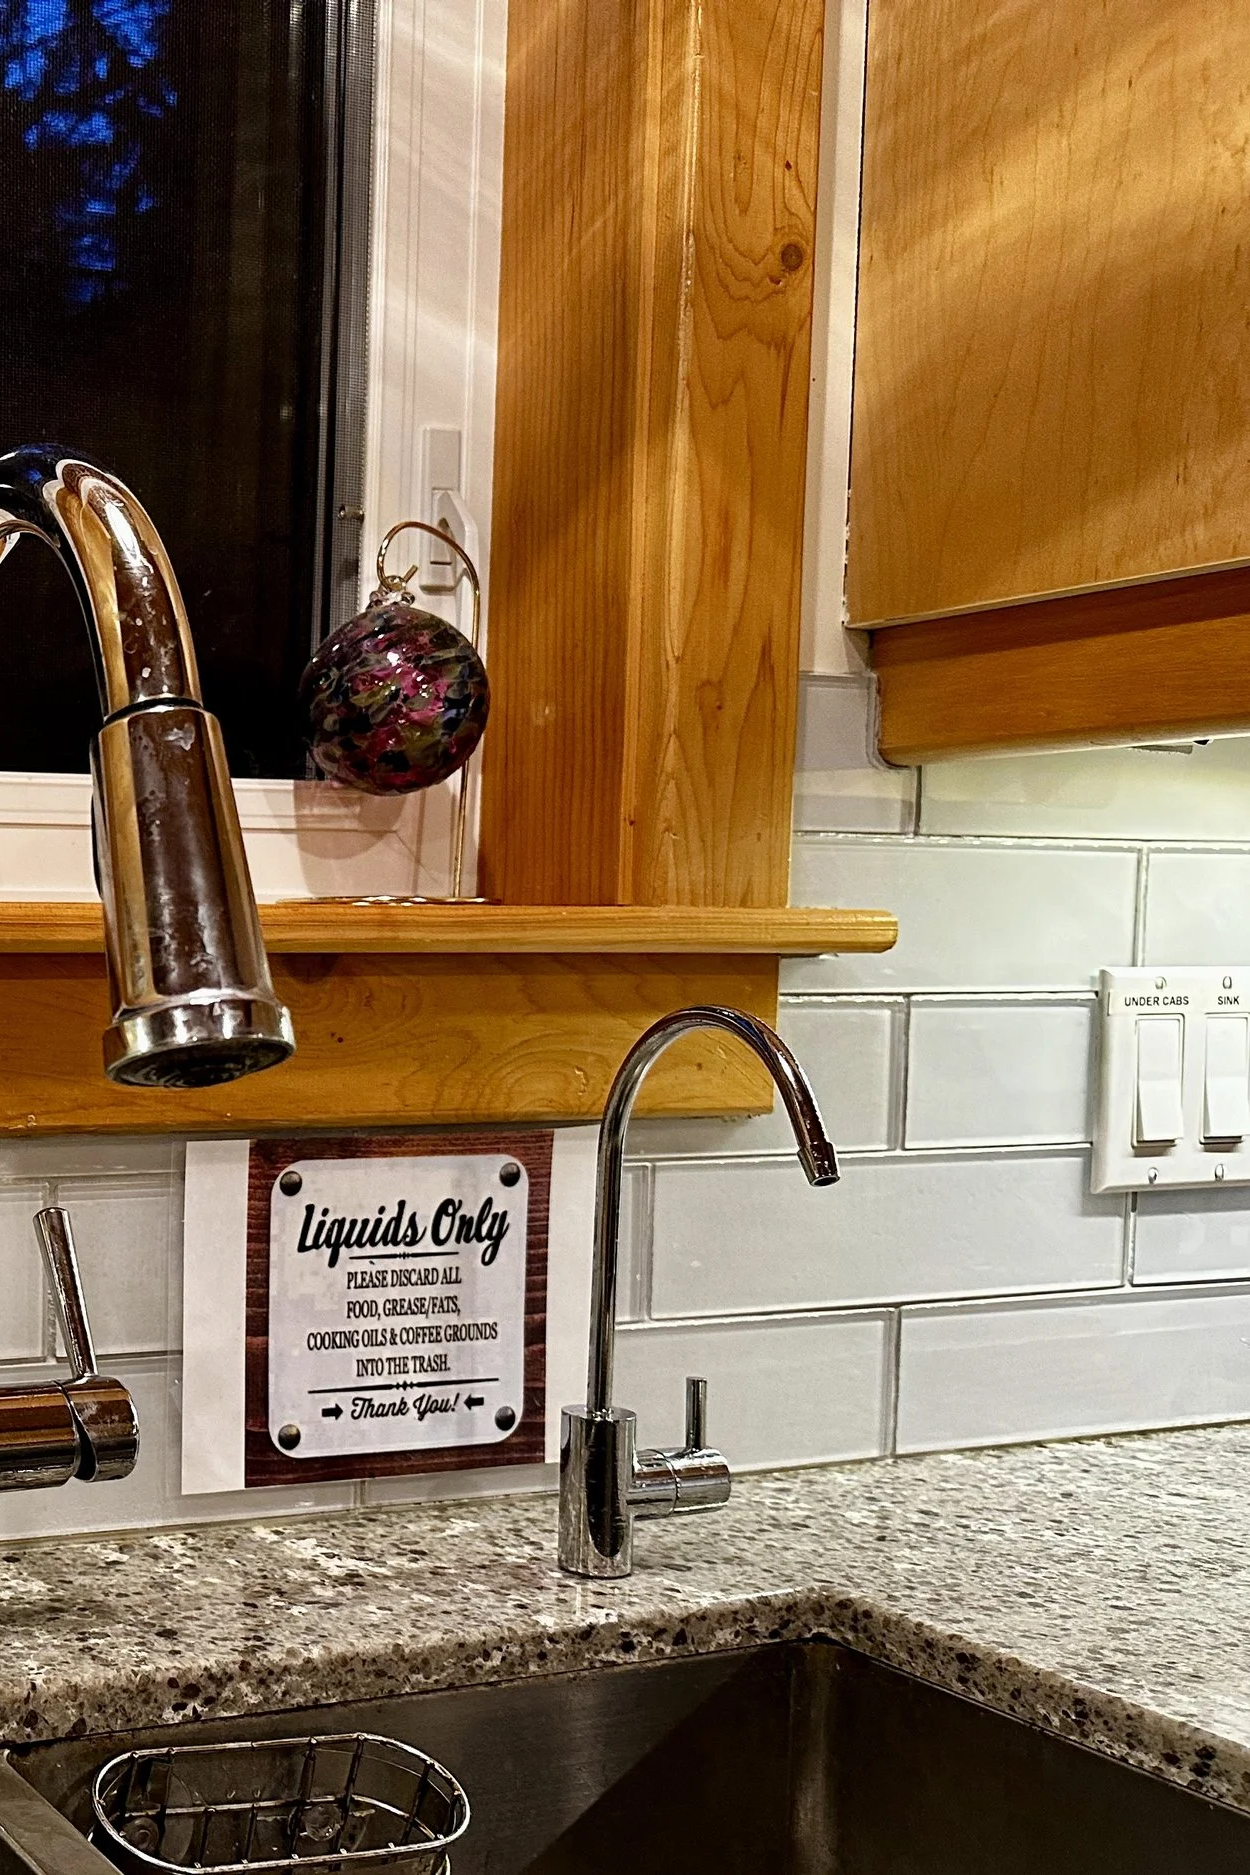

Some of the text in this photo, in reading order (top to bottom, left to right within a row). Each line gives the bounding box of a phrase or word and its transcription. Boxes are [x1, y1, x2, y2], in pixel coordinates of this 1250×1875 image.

[1125, 996, 1189, 1006] UNDER CABS
[1218, 996, 1239, 1005] SINK
[297, 1197, 510, 1268] Liquids Only
[347, 1267, 462, 1289] PLEASE DISCARD ALL
[346, 1296, 461, 1320] FOOD, GREASE/FATS,
[307, 1322, 497, 1351] COOKING OILS & COFFEE GROUNDS
[356, 1354, 450, 1377] INTO THE TRASH.
[351, 1393, 460, 1421] Thank You!
